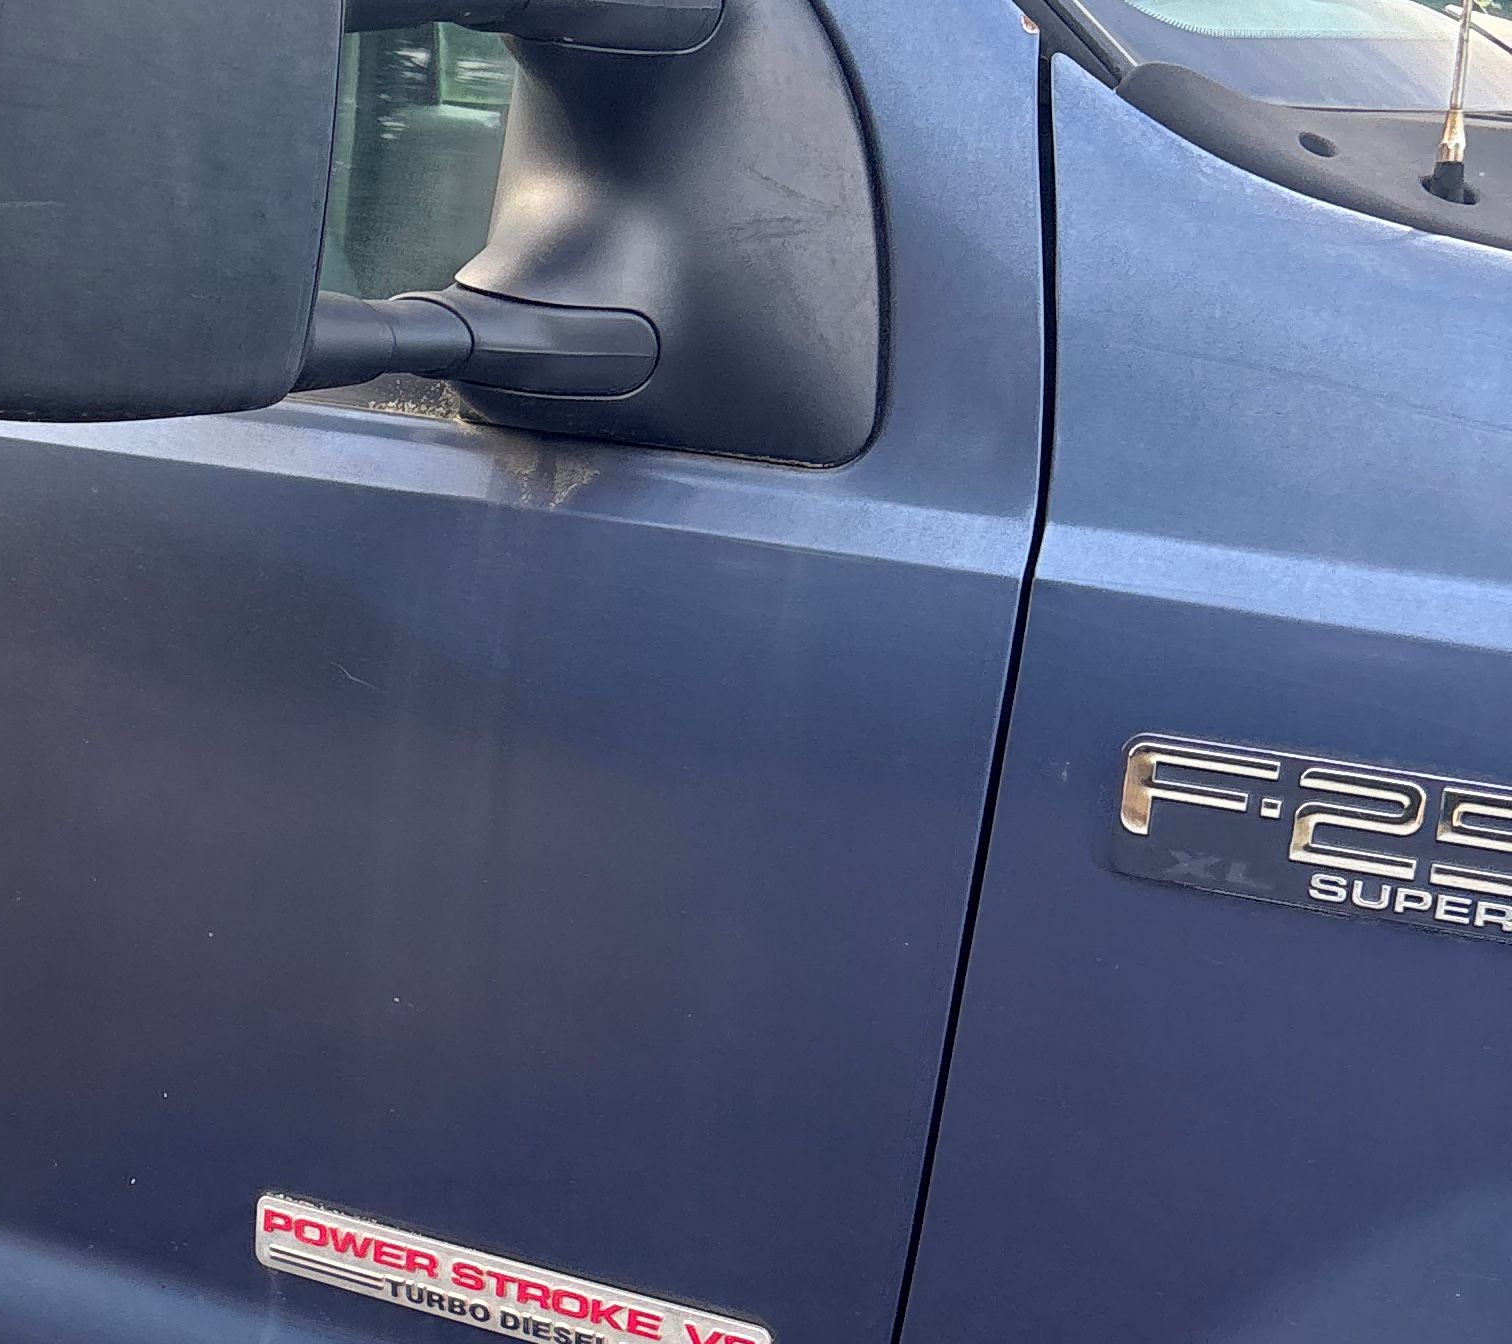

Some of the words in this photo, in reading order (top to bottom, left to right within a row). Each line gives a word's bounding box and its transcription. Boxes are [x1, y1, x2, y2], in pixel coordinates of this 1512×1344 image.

[1308, 872, 1512, 933] SUPER
[262, 1208, 440, 1281] POWER
[450, 1258, 664, 1341] STROKE
[385, 1276, 491, 1324] TURBO
